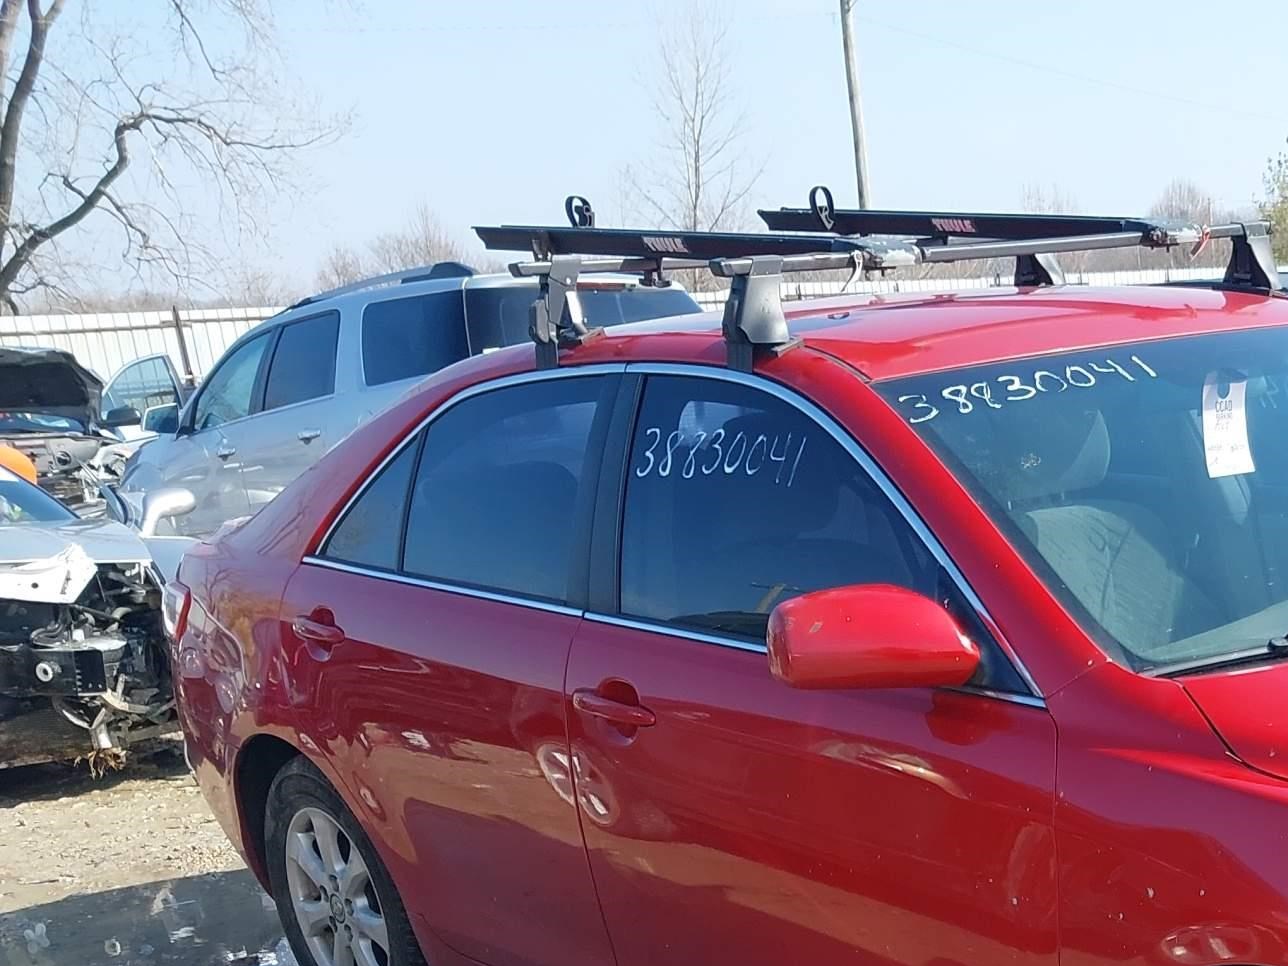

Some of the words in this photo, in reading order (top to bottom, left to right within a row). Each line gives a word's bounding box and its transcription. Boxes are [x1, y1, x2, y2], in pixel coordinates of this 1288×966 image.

[932, 218, 976, 233] THULE
[641, 236, 689, 253] THULE
[636, 428, 807, 487] 38830041
